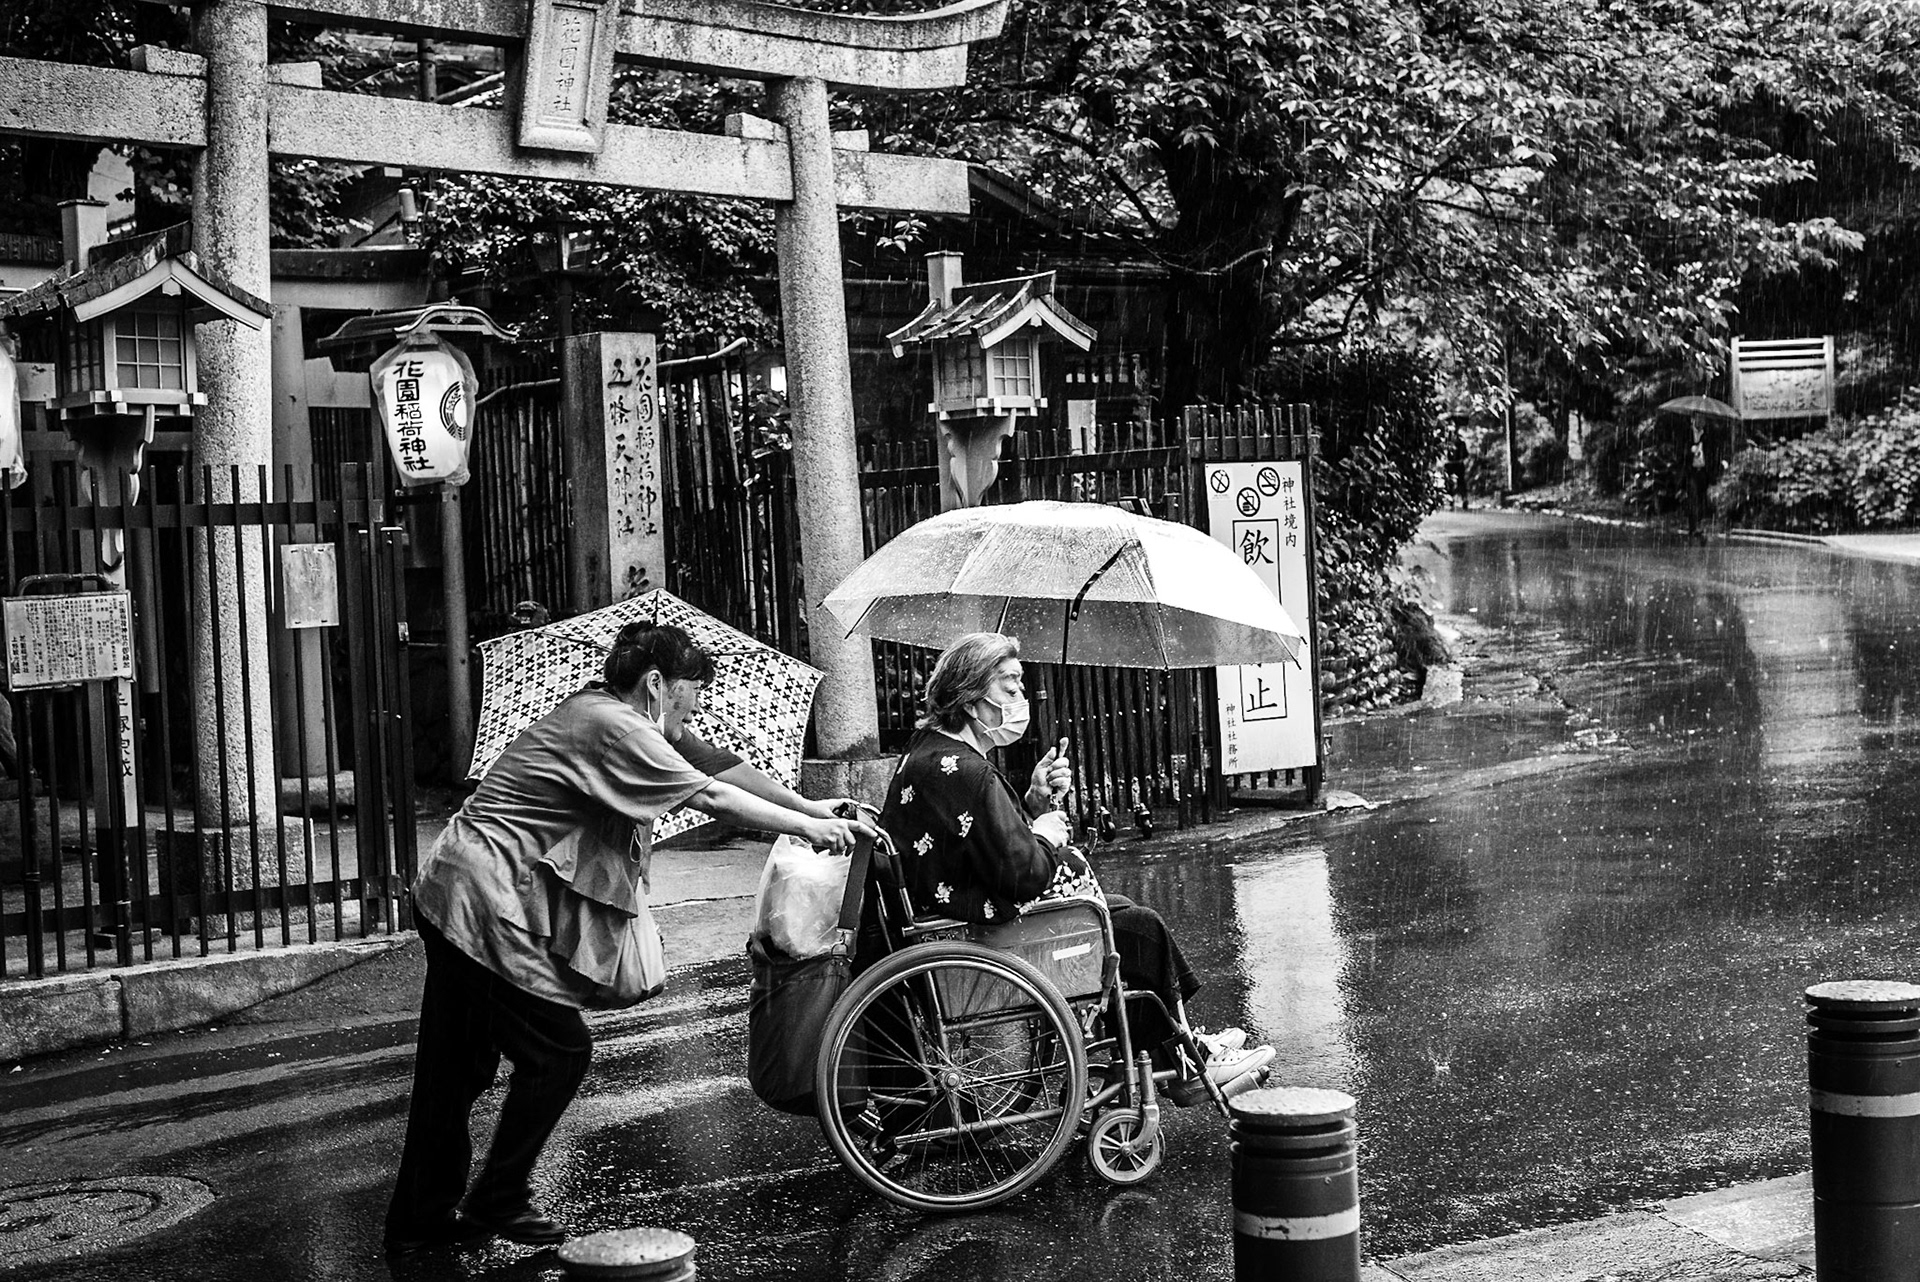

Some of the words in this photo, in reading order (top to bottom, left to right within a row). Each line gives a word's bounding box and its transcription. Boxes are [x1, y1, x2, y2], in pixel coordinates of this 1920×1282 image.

[393, 360, 435, 472] 花園稲荷神社
[1281, 477, 1298, 548] 神社境内
